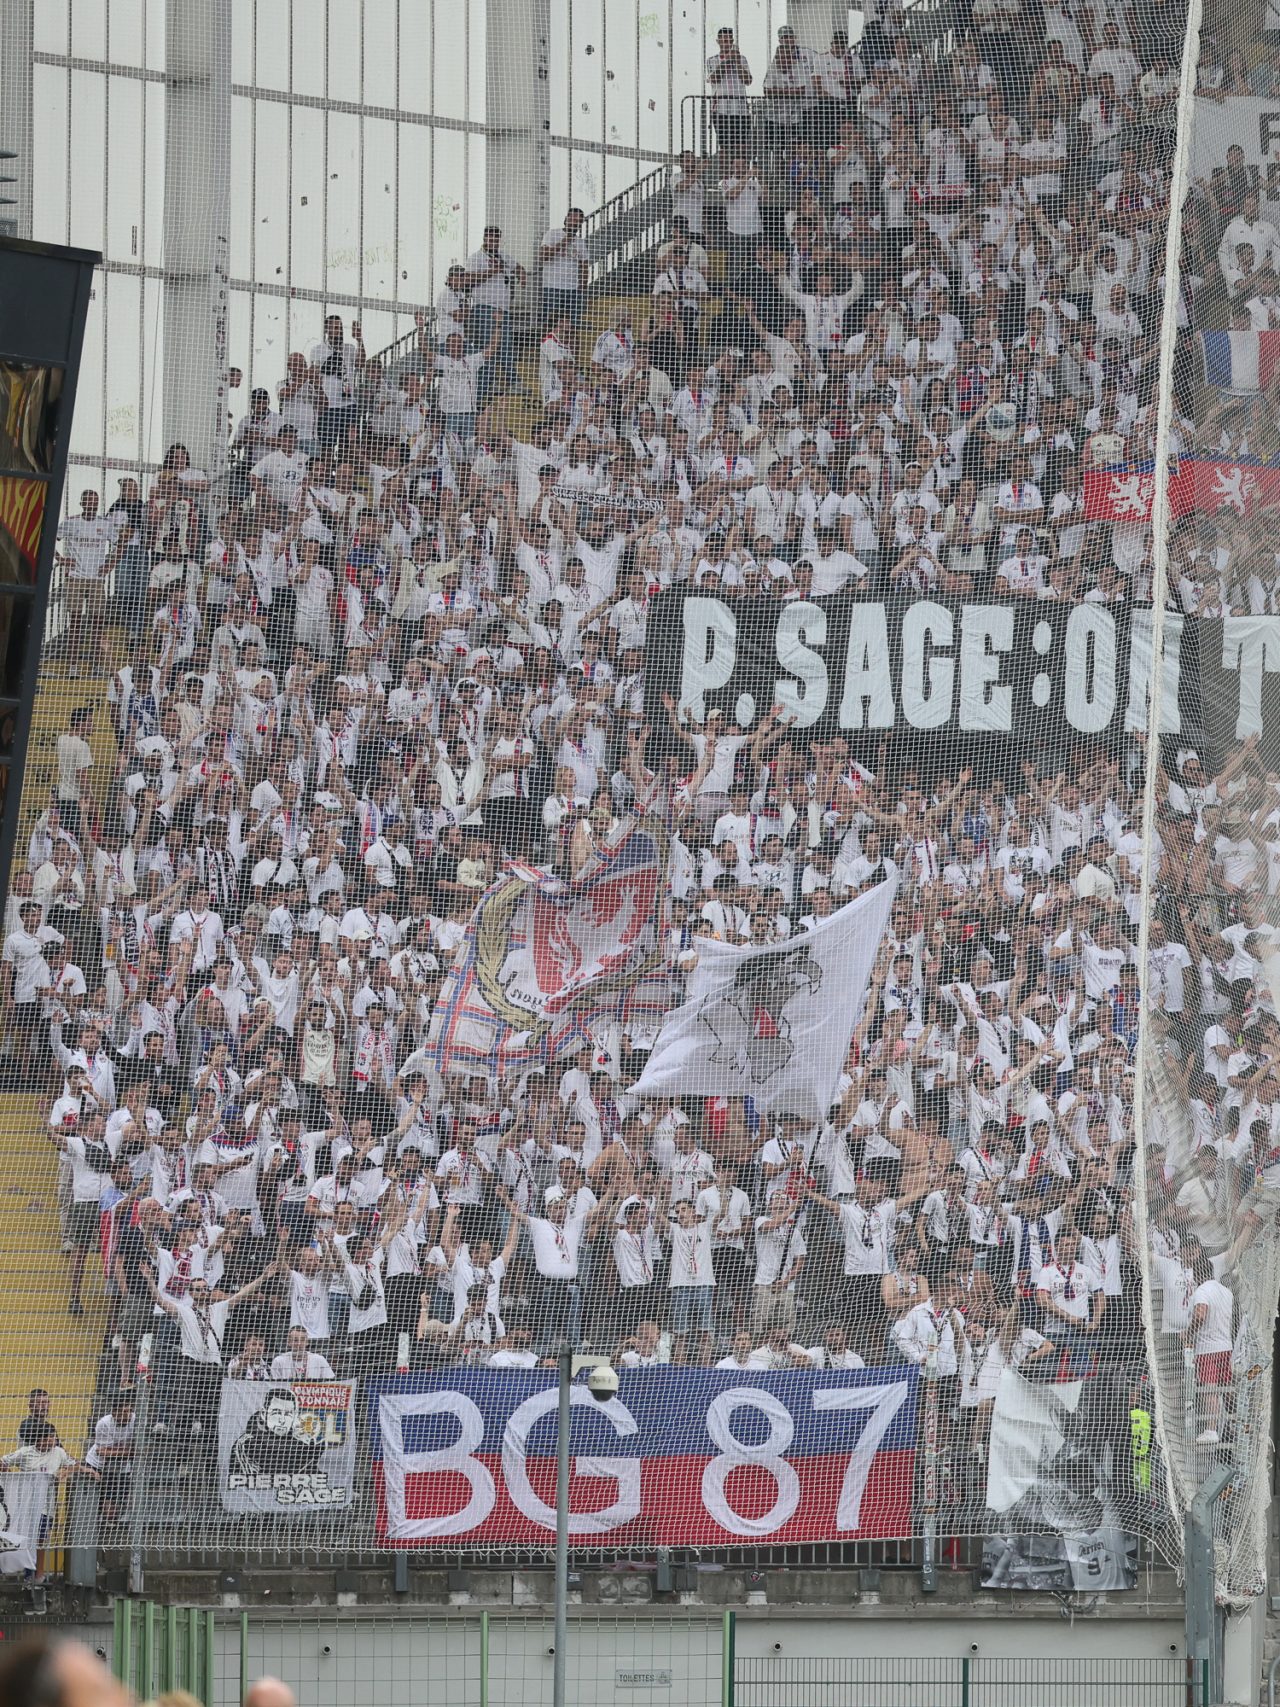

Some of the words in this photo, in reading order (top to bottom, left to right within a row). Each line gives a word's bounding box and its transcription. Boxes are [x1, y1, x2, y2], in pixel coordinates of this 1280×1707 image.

[294, 1386, 348, 1399] OLYMPIQUE
[297, 1397, 347, 1407] YONNAIS
[378, 1386, 641, 1538] BG
[701, 1380, 908, 1536] 87
[229, 1473, 329, 1489] PIERRE
[276, 1486, 346, 1504] SAGE
[619, 1674, 655, 1682] TOILETTES
